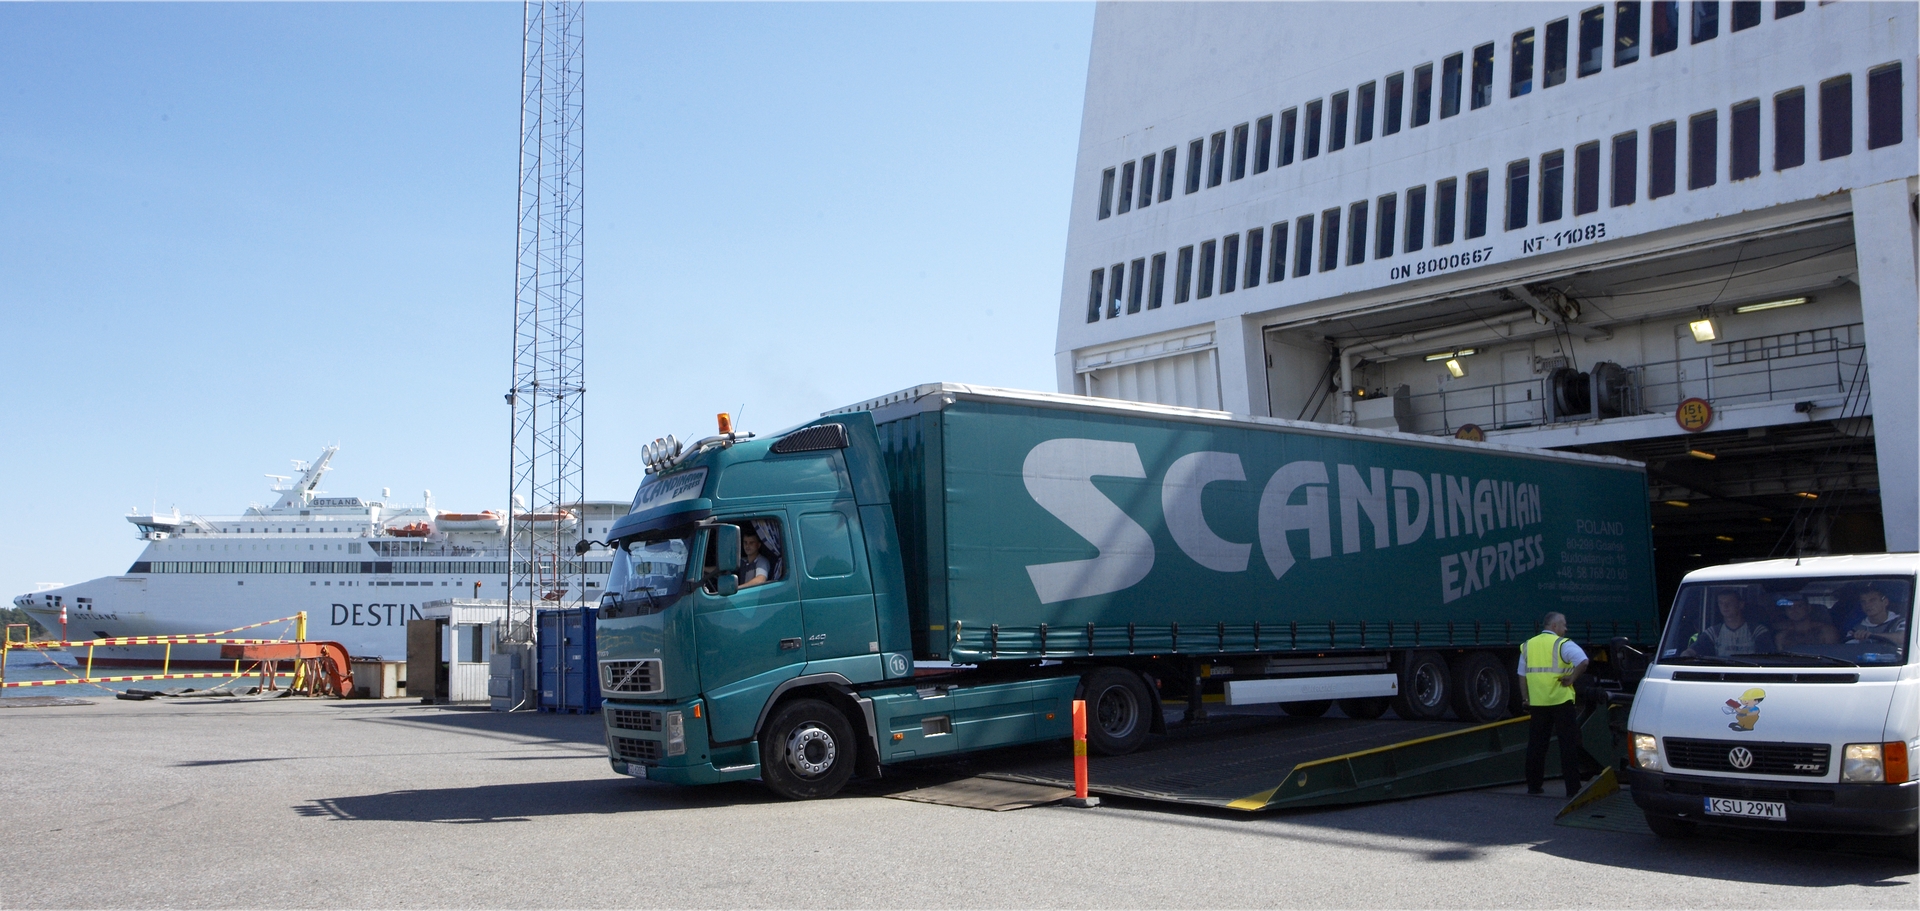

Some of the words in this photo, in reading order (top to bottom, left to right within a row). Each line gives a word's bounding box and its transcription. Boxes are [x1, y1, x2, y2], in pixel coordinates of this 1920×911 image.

[1417, 246, 1494, 275] 8000667
[1523, 236, 1544, 254] NT
[1683, 405, 1696, 415] 15
[1697, 404, 1702, 414] t
[630, 471, 704, 514] SCANDINAVIAN
[672, 480, 700, 499] EXPRESS
[1022, 437, 1541, 604] SCANDINAVIAN
[1576, 519, 1624, 536] POLAND
[1441, 533, 1545, 605] EXPRESS
[1605, 567, 1616, 579] 20
[74, 613, 118, 621] GOTLAND
[808, 633, 826, 641] 440
[892, 659, 905, 671] 18
[1712, 799, 1742, 813] KSU
[1747, 802, 1783, 817] 29WY
